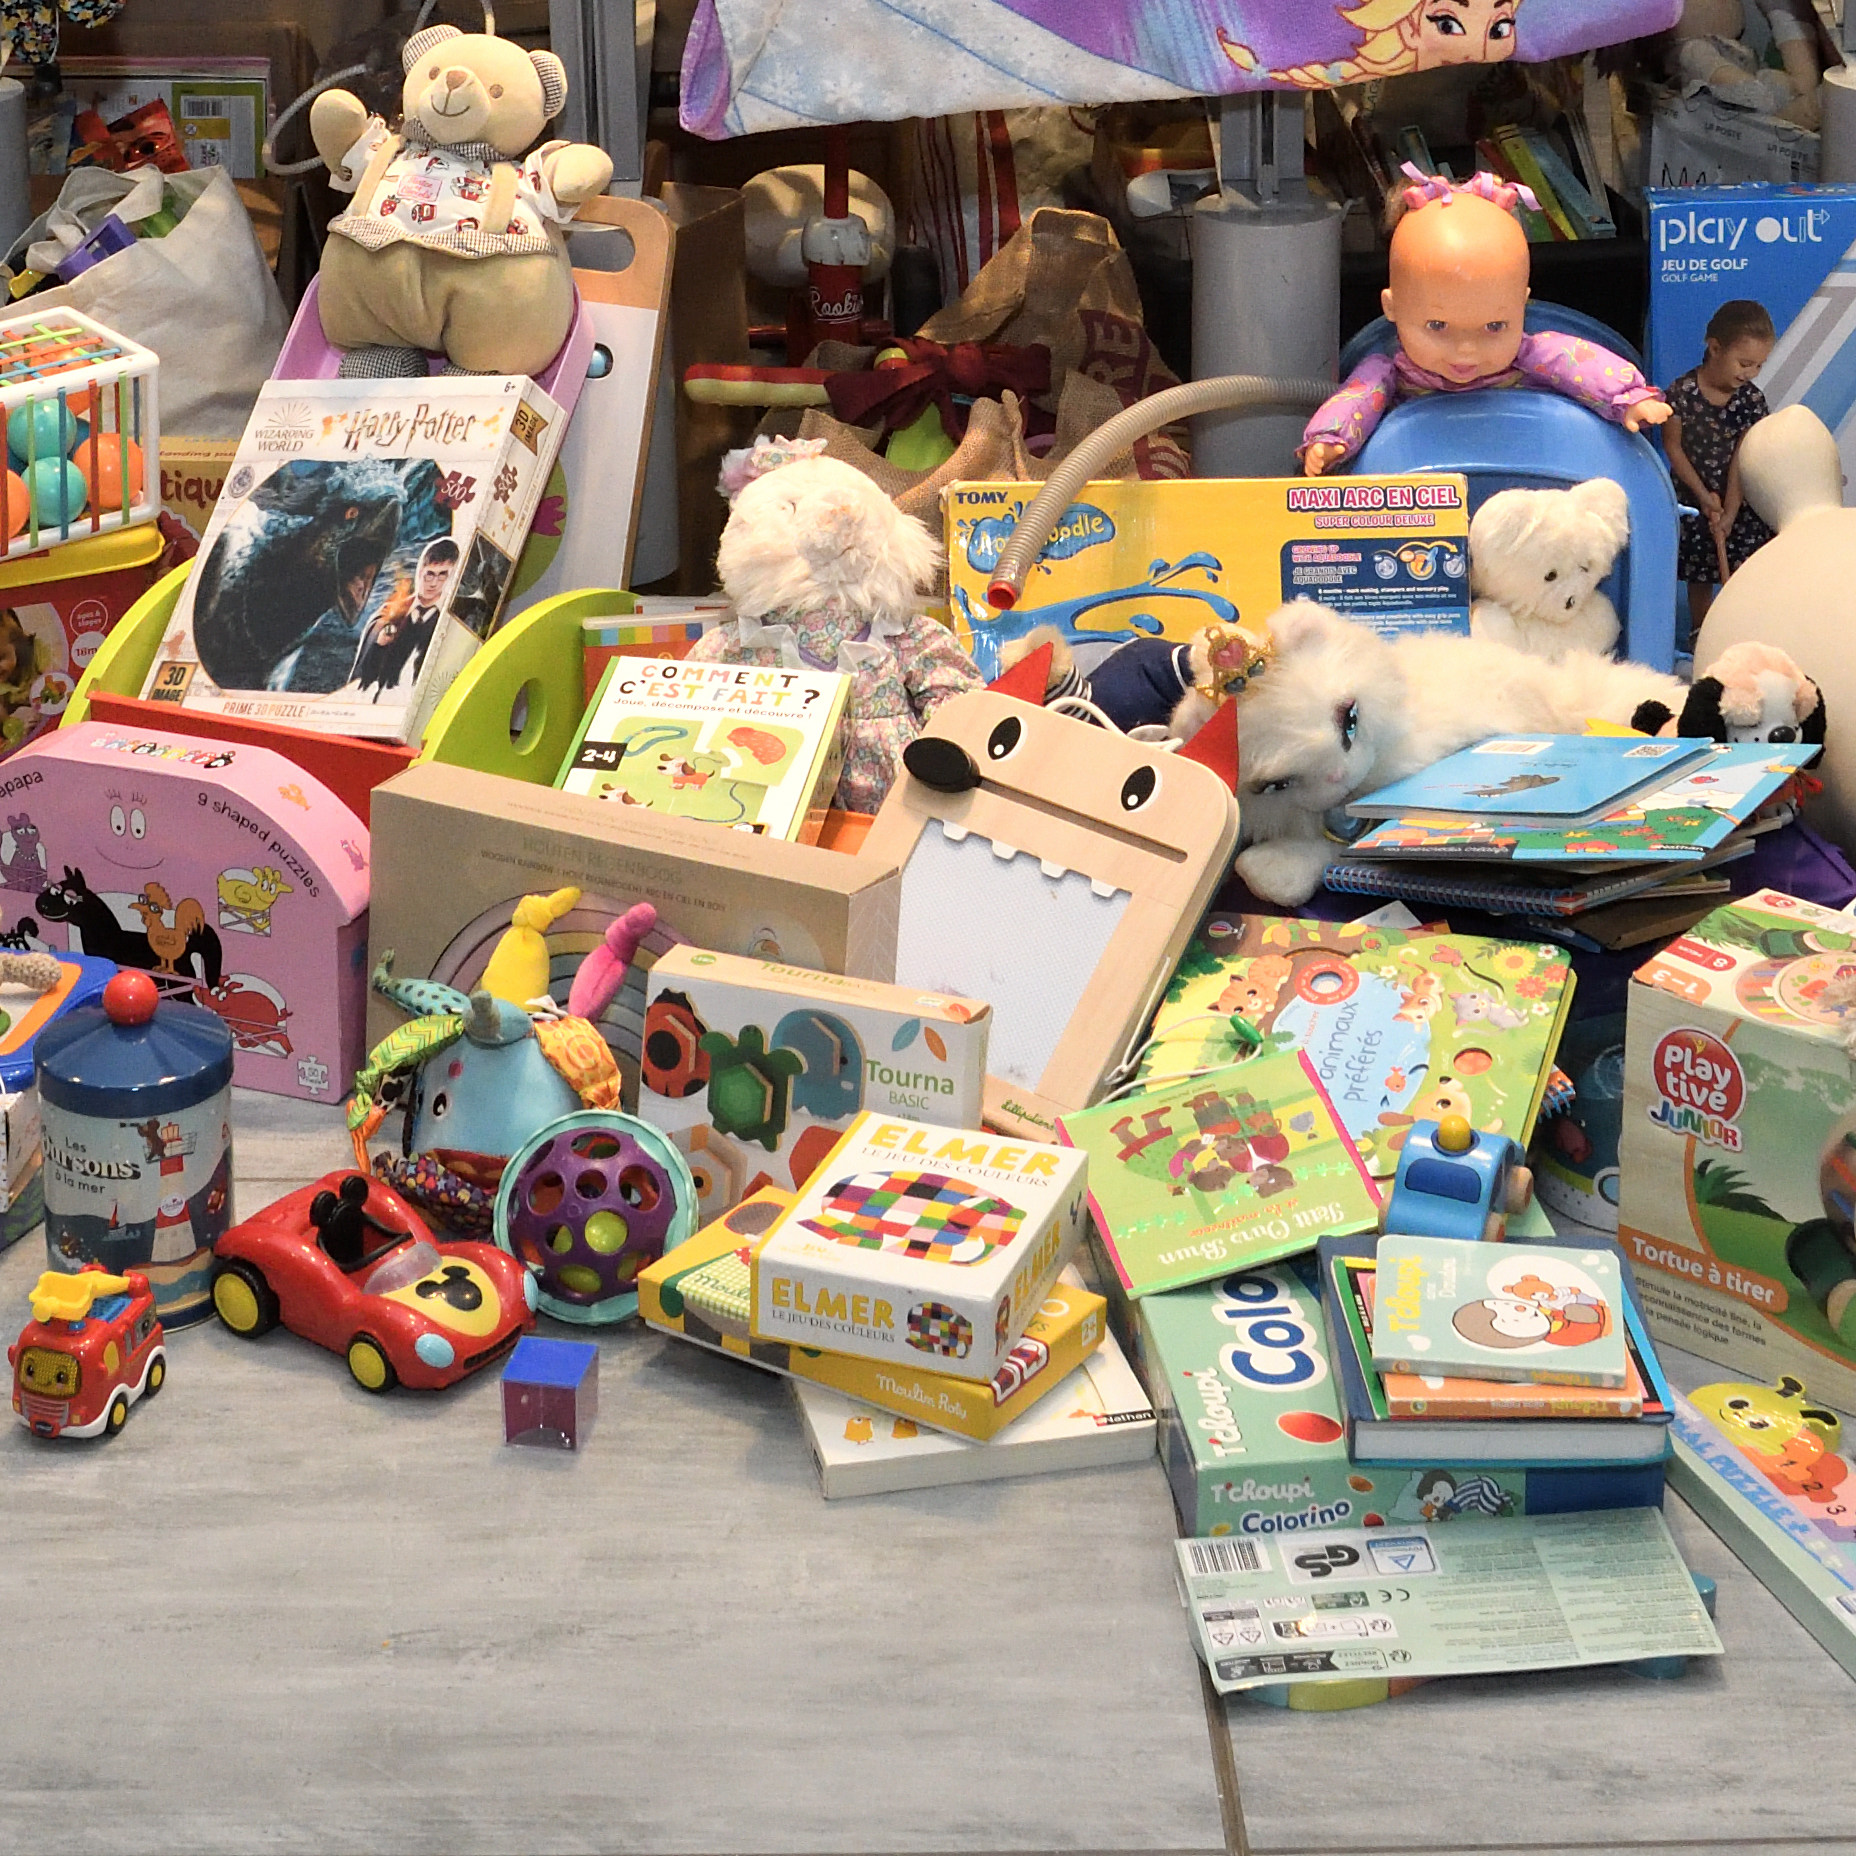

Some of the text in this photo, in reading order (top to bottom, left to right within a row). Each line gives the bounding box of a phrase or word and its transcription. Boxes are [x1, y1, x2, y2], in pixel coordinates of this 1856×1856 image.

[1661, 257, 1749, 271] JEU DE GOLF
[1661, 271, 1718, 283] GOLF GAME
[254, 428, 315, 440] WIZARDING
[345, 402, 476, 456] Harry Potter
[257, 440, 304, 452] WORLD
[444, 479, 467, 501] 500
[955, 491, 1009, 506] TOMY
[1288, 485, 1462, 510] MAXI ARC EN CIEL
[1314, 513, 1436, 529] SUPER COLOUR DELUXE
[162, 665, 186, 686] 3D
[641, 664, 800, 689] COMMENT
[619, 678, 793, 707] C'EST FAIT
[223, 701, 305, 719] PRIME PUZZLE
[651, 700, 804, 720] décompose découvre
[581, 748, 617, 763] 2-4
[212, 798, 322, 900] shaped puzzles
[865, 1058, 955, 1096] Tourna
[1344, 1027, 1384, 1104] préférés
[888, 1089, 930, 1111] BASIC
[1665, 1071, 1729, 1114] tive
[65, 1136, 87, 1152] Les
[868, 1122, 1061, 1178] ELMER
[861, 1146, 1049, 1188] LE JEU DES COULEURS
[63, 1173, 107, 1196] la mer
[1158, 1231, 1227, 1266] Brun
[1631, 1236, 1775, 1305] Tortue tirer
[771, 1276, 896, 1329] ELMER
[1684, 1290, 1728, 1321] motricité
[772, 1309, 896, 1344] LE JEU DES COULEURS
[1655, 1308, 1730, 1346] pensée logique
[1731, 1322, 1767, 1347] formes
[875, 1372, 969, 1420] Moulin Roty
[1105, 1410, 1152, 1424] Nathan
[1184, 1367, 1244, 1459] T'choupi
[1211, 1476, 1315, 1504] T'choupi
[1242, 1500, 1351, 1535] Colorino
